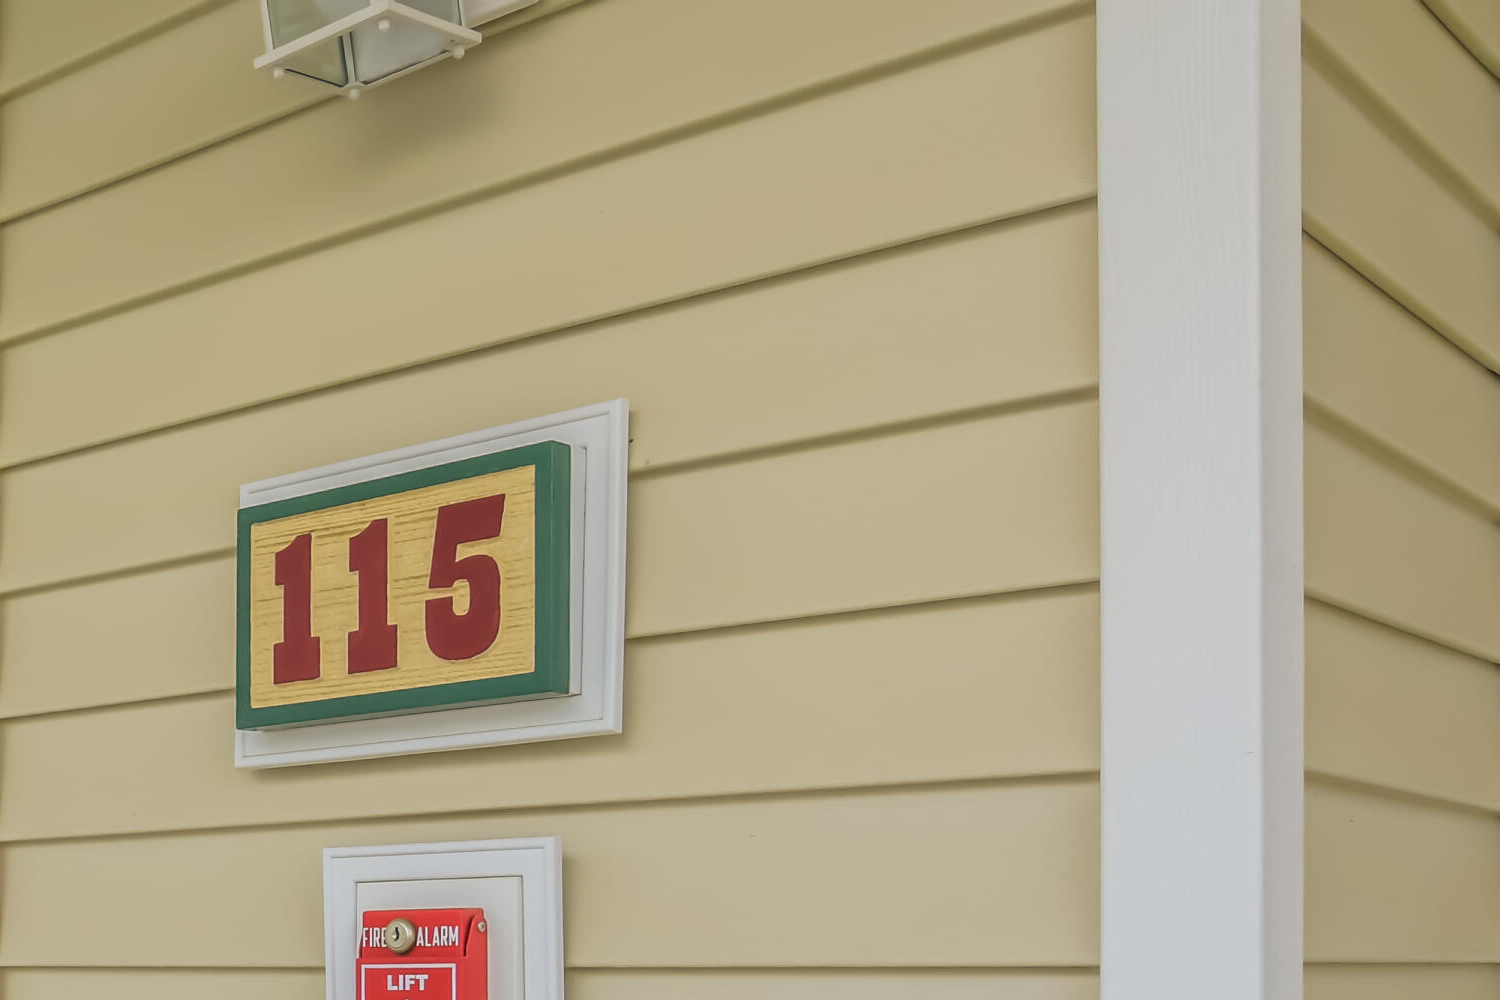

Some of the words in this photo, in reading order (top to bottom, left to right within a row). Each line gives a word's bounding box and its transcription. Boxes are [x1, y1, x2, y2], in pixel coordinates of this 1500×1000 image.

[273, 493, 506, 685] 115
[362, 927, 387, 947] FIRE
[416, 925, 459, 946] ALARM
[387, 974, 429, 991] LIFT
